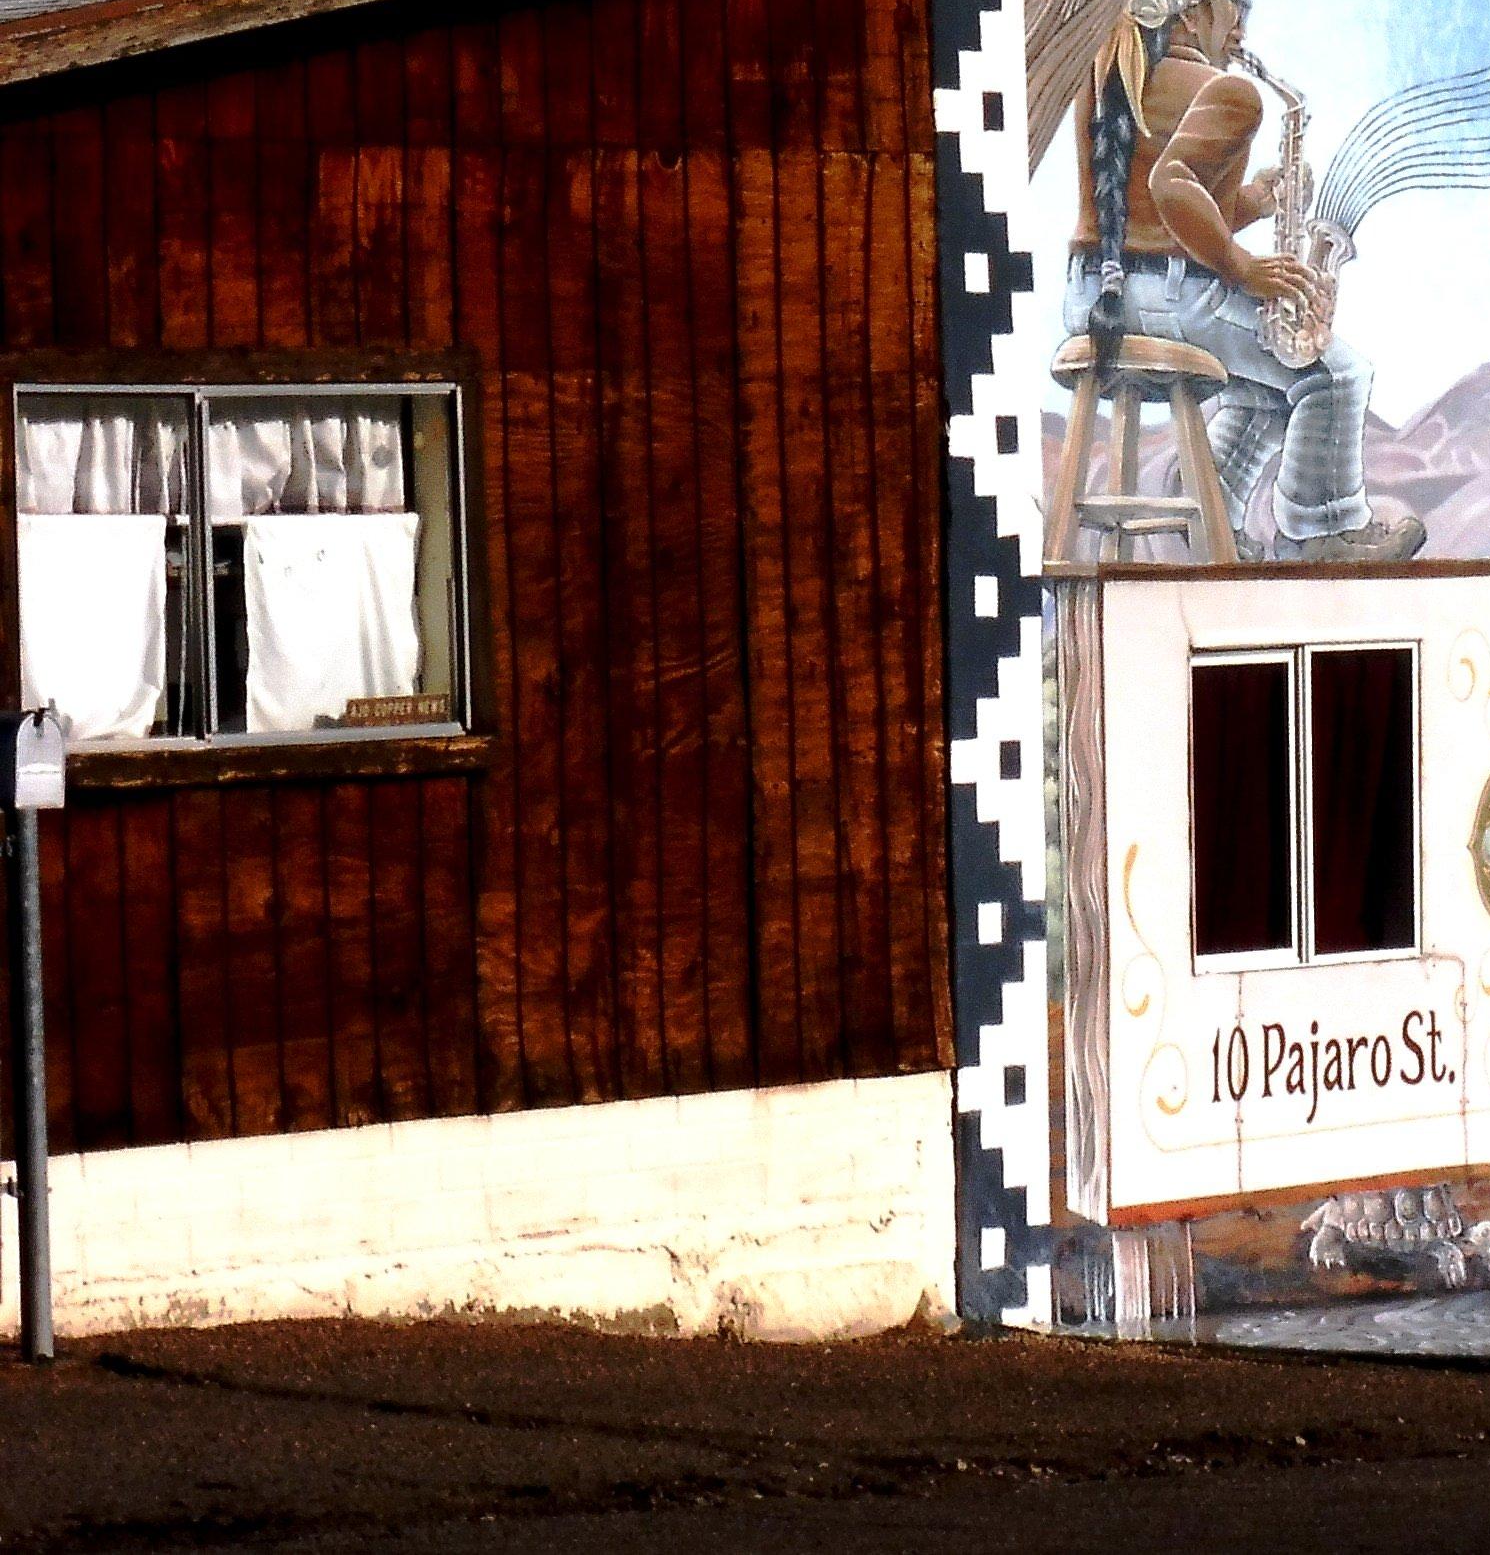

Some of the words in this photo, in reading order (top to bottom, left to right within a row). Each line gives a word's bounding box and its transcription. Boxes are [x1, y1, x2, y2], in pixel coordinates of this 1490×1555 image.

[1212, 1026, 1249, 1103] 10
[1261, 1020, 1392, 1124] Pajaro
[1400, 1010, 1455, 1085] St.
